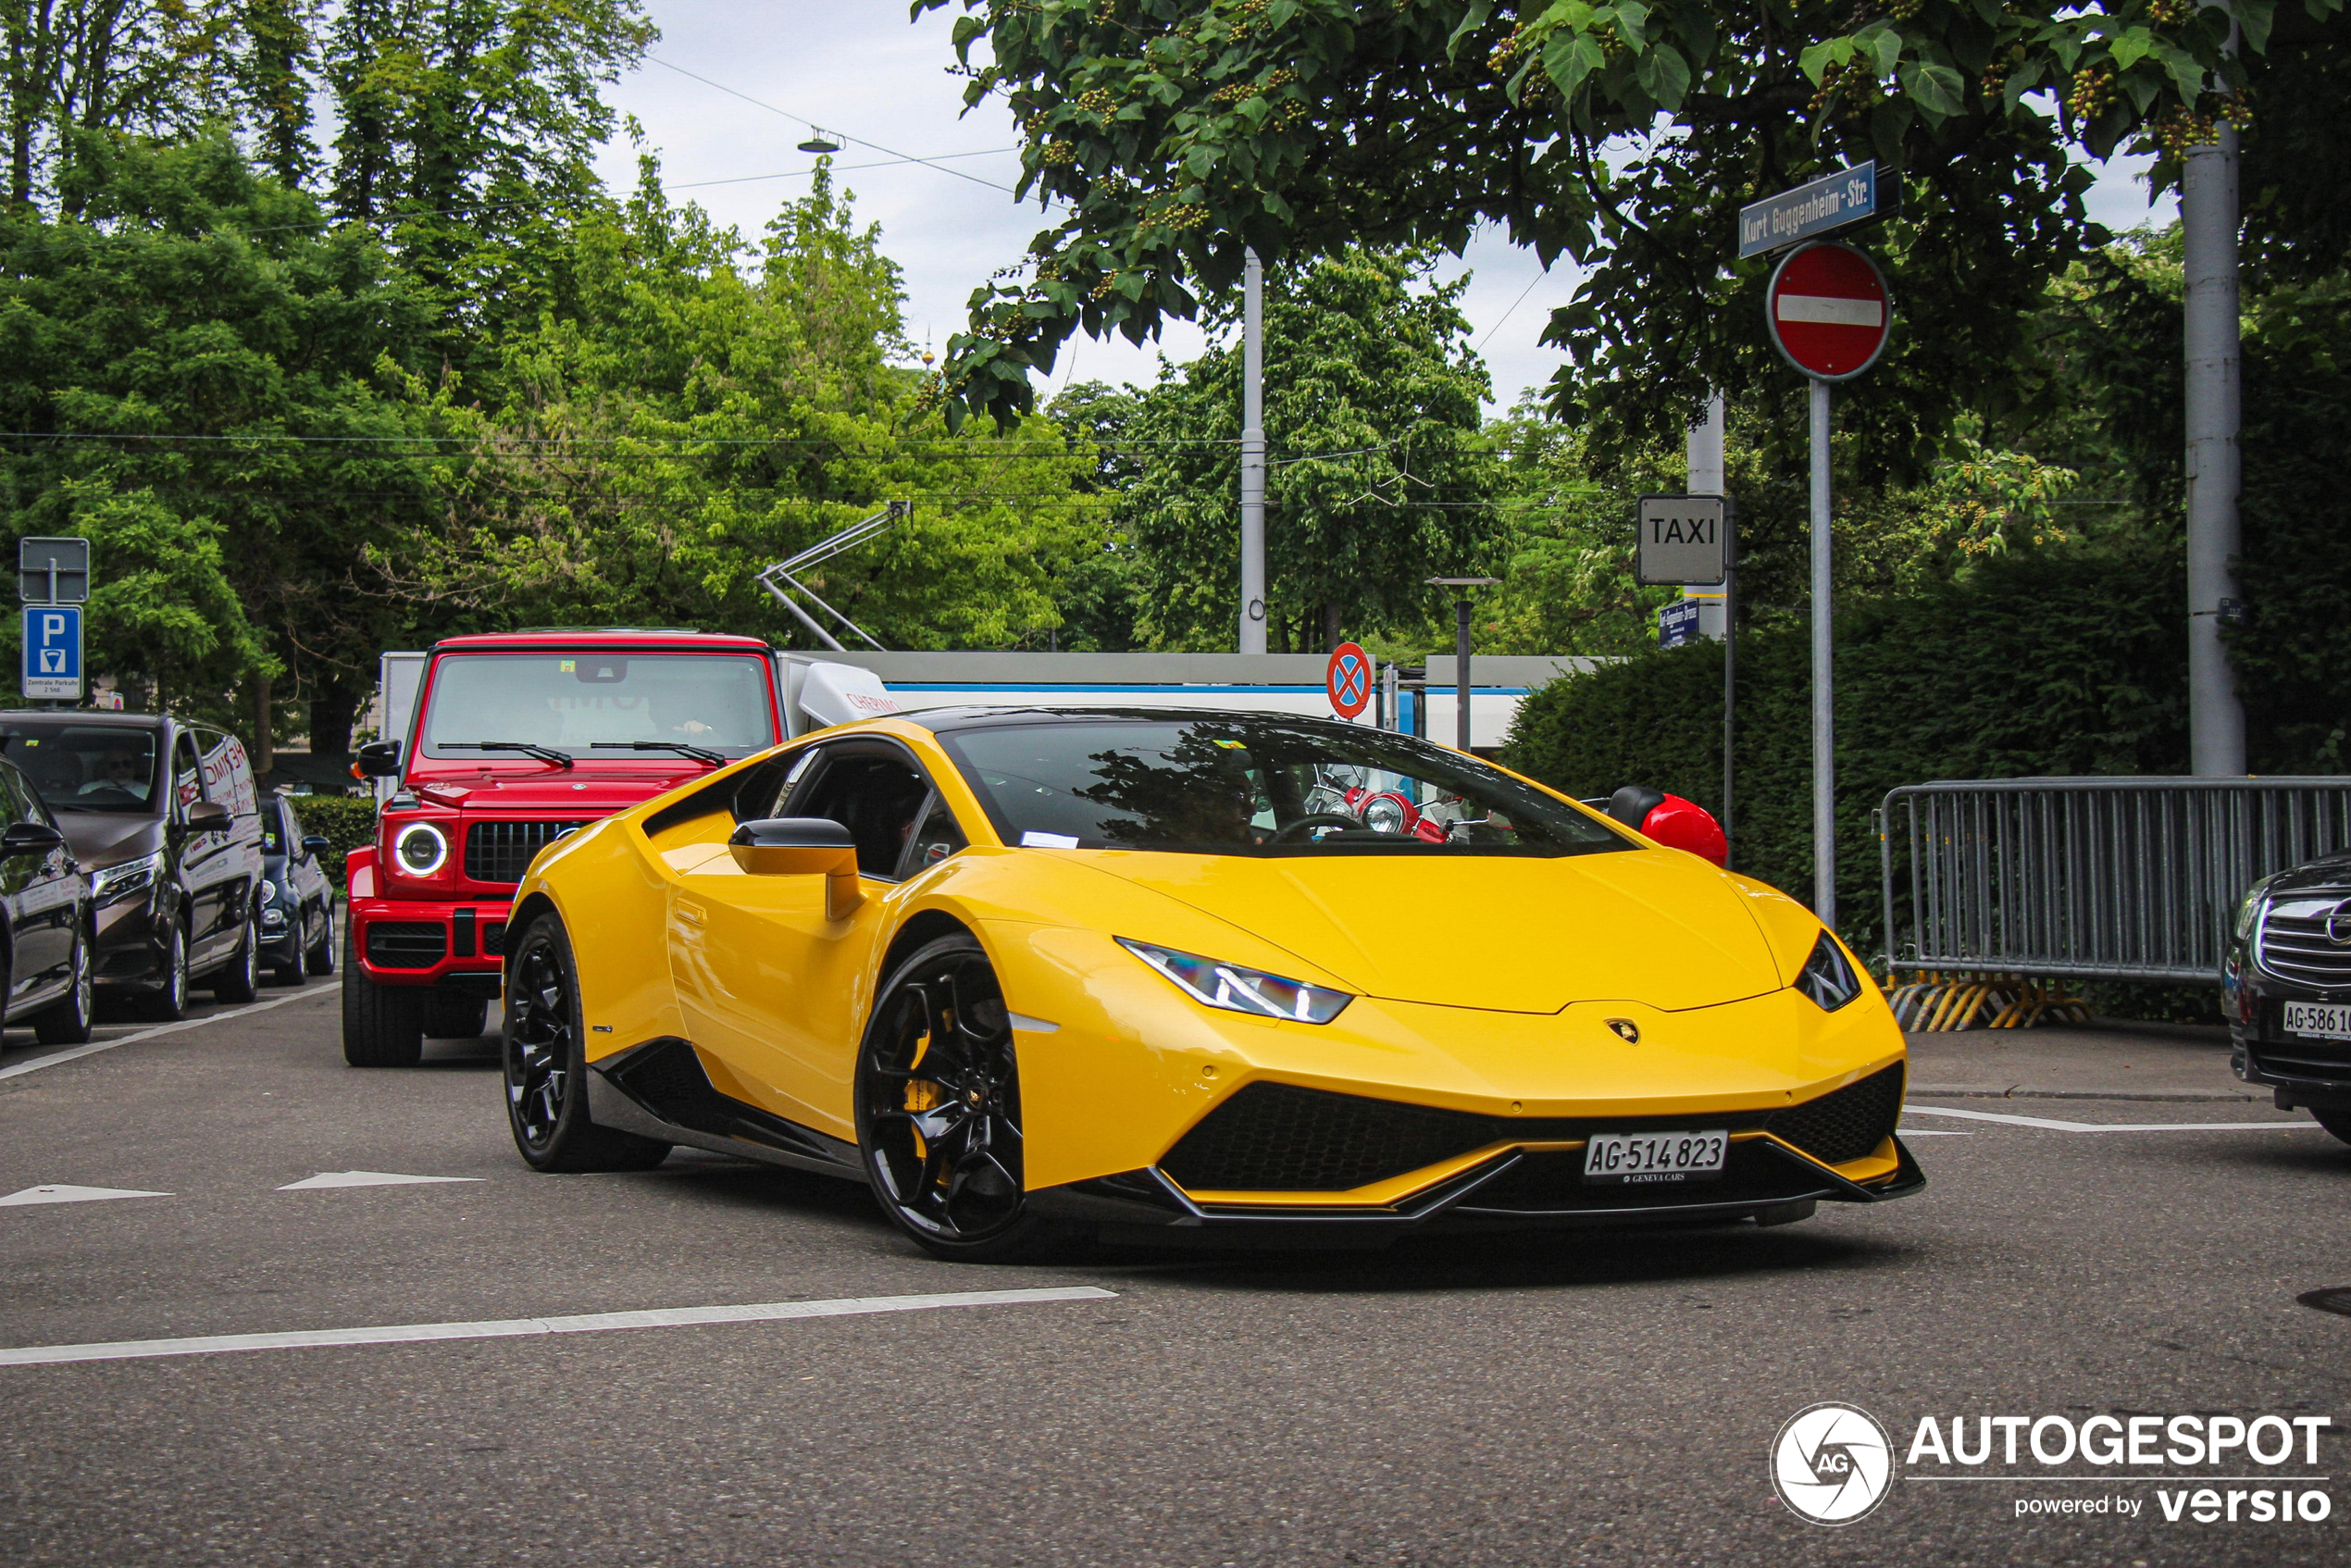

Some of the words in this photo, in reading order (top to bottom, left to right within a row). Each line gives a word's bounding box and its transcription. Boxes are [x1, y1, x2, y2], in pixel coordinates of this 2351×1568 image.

[1744, 212, 1768, 244] Kurt
[1773, 178, 1868, 237] Guggenheim-Str.
[1648, 518, 1715, 544] TAXI
[44, 614, 66, 647] P
[1632, 1174, 1663, 1183] GENEVA
[1664, 1173, 1685, 1181] CARS
